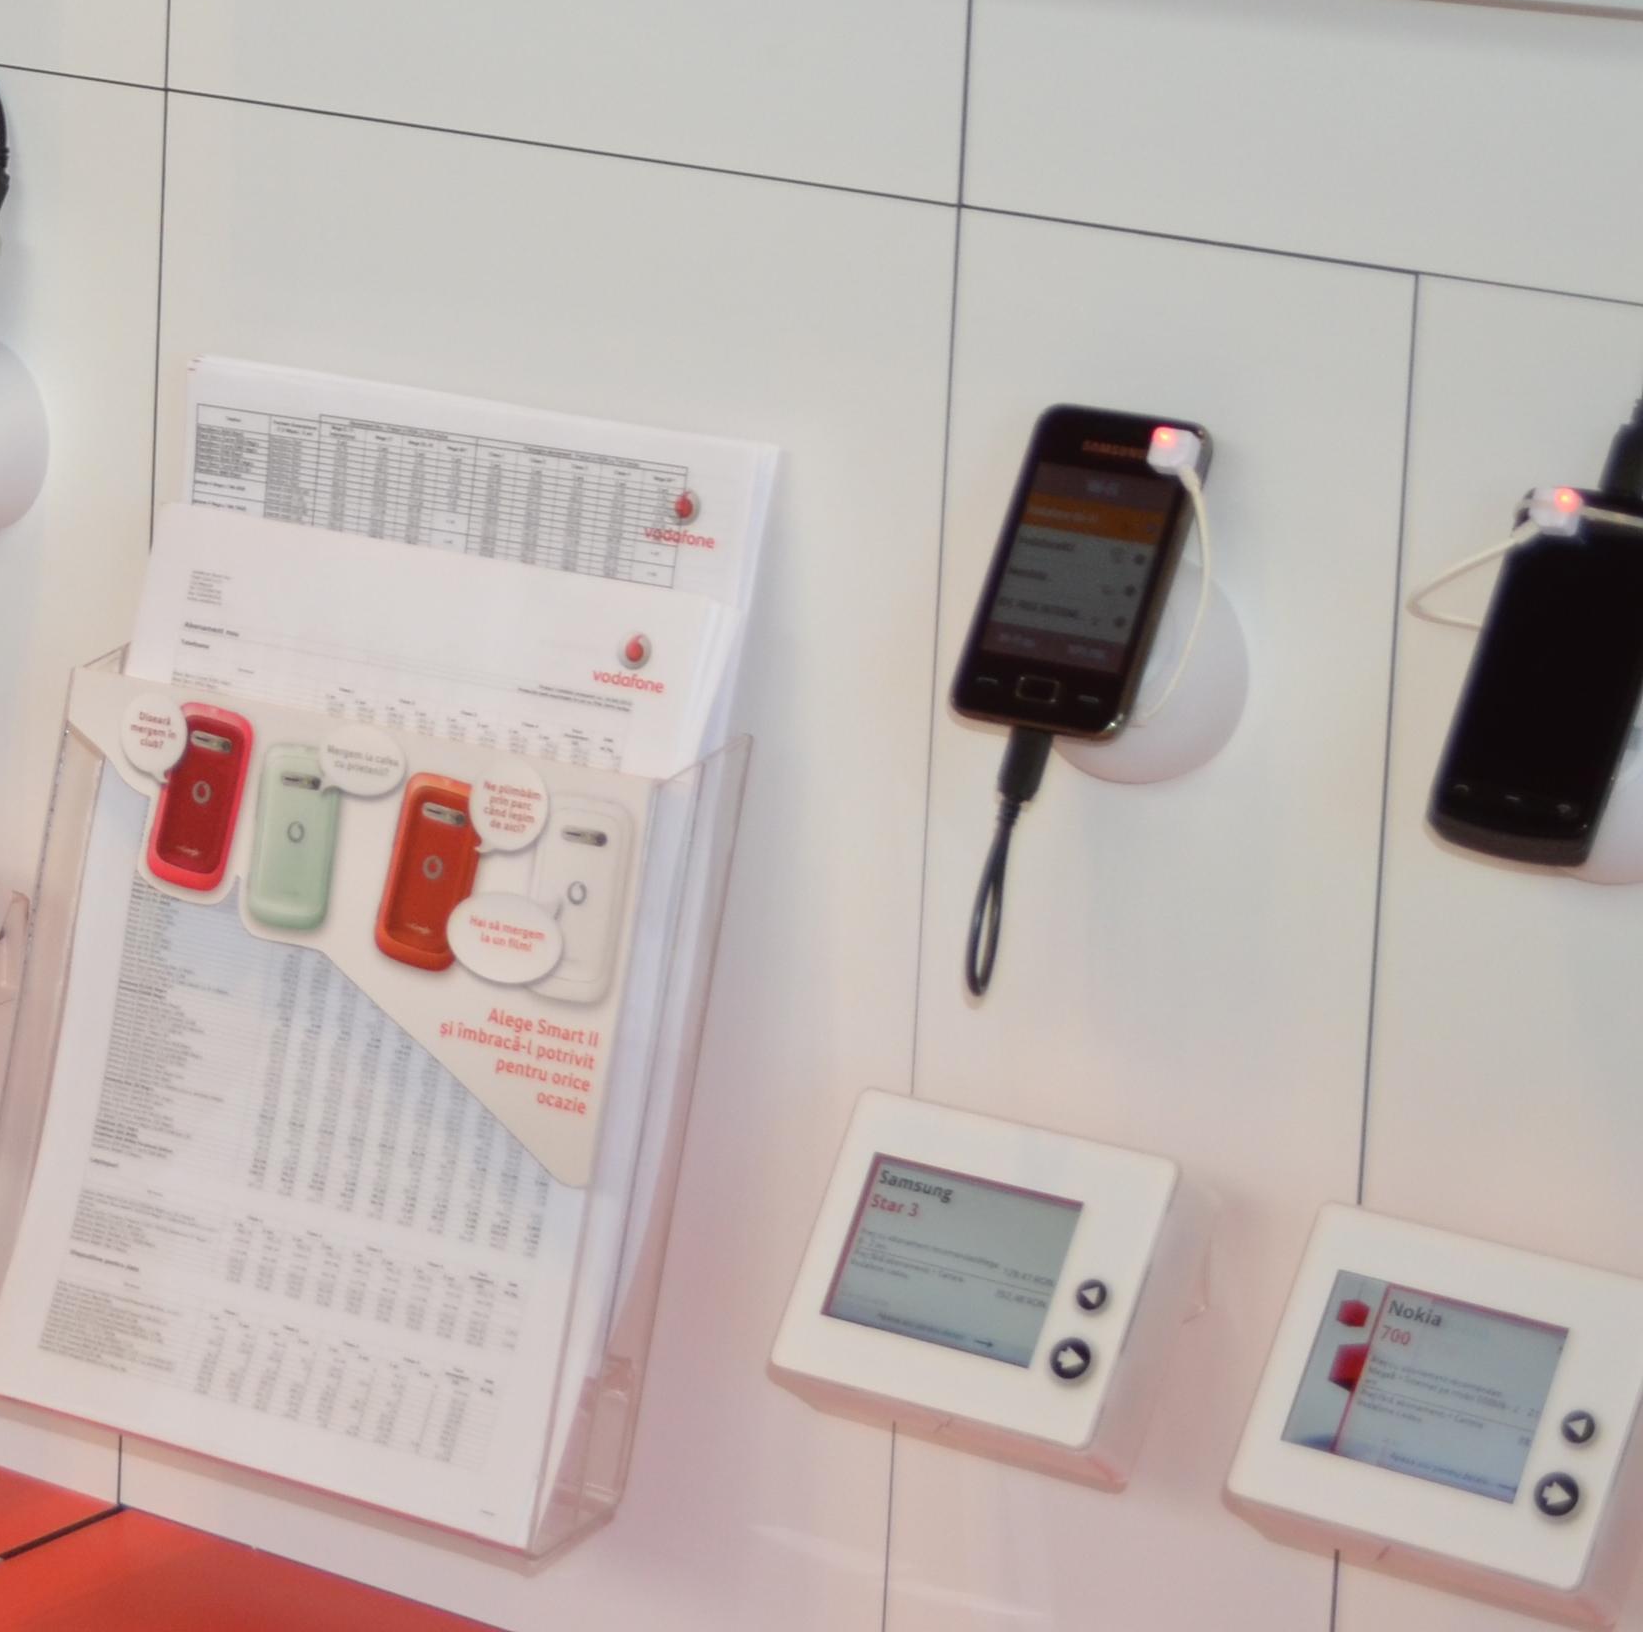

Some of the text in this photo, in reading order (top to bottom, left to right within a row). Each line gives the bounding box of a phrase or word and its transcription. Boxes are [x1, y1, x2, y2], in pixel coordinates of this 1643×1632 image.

[643, 525, 716, 549] vodafone
[593, 668, 665, 695] vodafone
[487, 1008, 533, 1034] Alege
[537, 1019, 579, 1044] Smart
[457, 1022, 533, 1056] îmbracă-l
[535, 1043, 596, 1071] potrivit
[495, 1058, 592, 1093] pentru orice
[536, 1090, 587, 1115] ocazie
[878, 1168, 954, 1205] Samsung
[870, 1193, 920, 1218] Star 3
[1388, 1299, 1443, 1328] Nokia
[1379, 1325, 1413, 1347] 700
